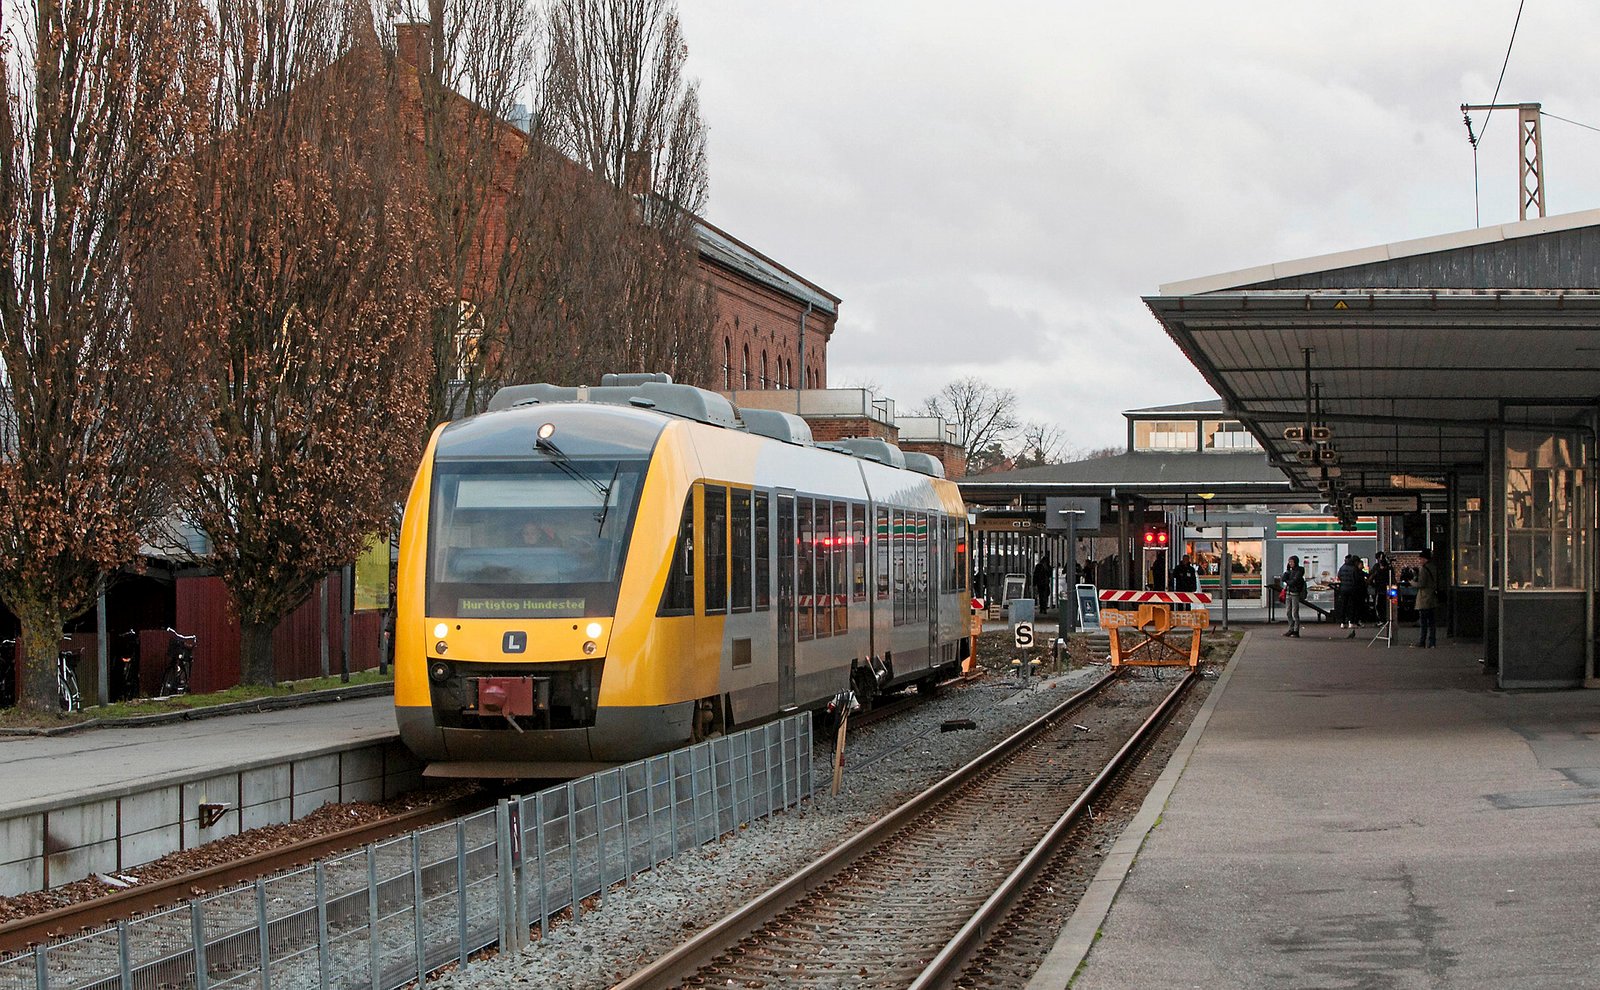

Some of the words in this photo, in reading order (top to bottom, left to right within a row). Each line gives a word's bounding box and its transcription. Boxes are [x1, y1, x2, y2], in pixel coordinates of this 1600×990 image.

[1467, 502, 1479, 510] 11
[463, 600, 520, 610] Hurtigtog
[523, 600, 585, 610] Hundested
[1016, 625, 1032, 645] S
[508, 635, 520, 650] L
